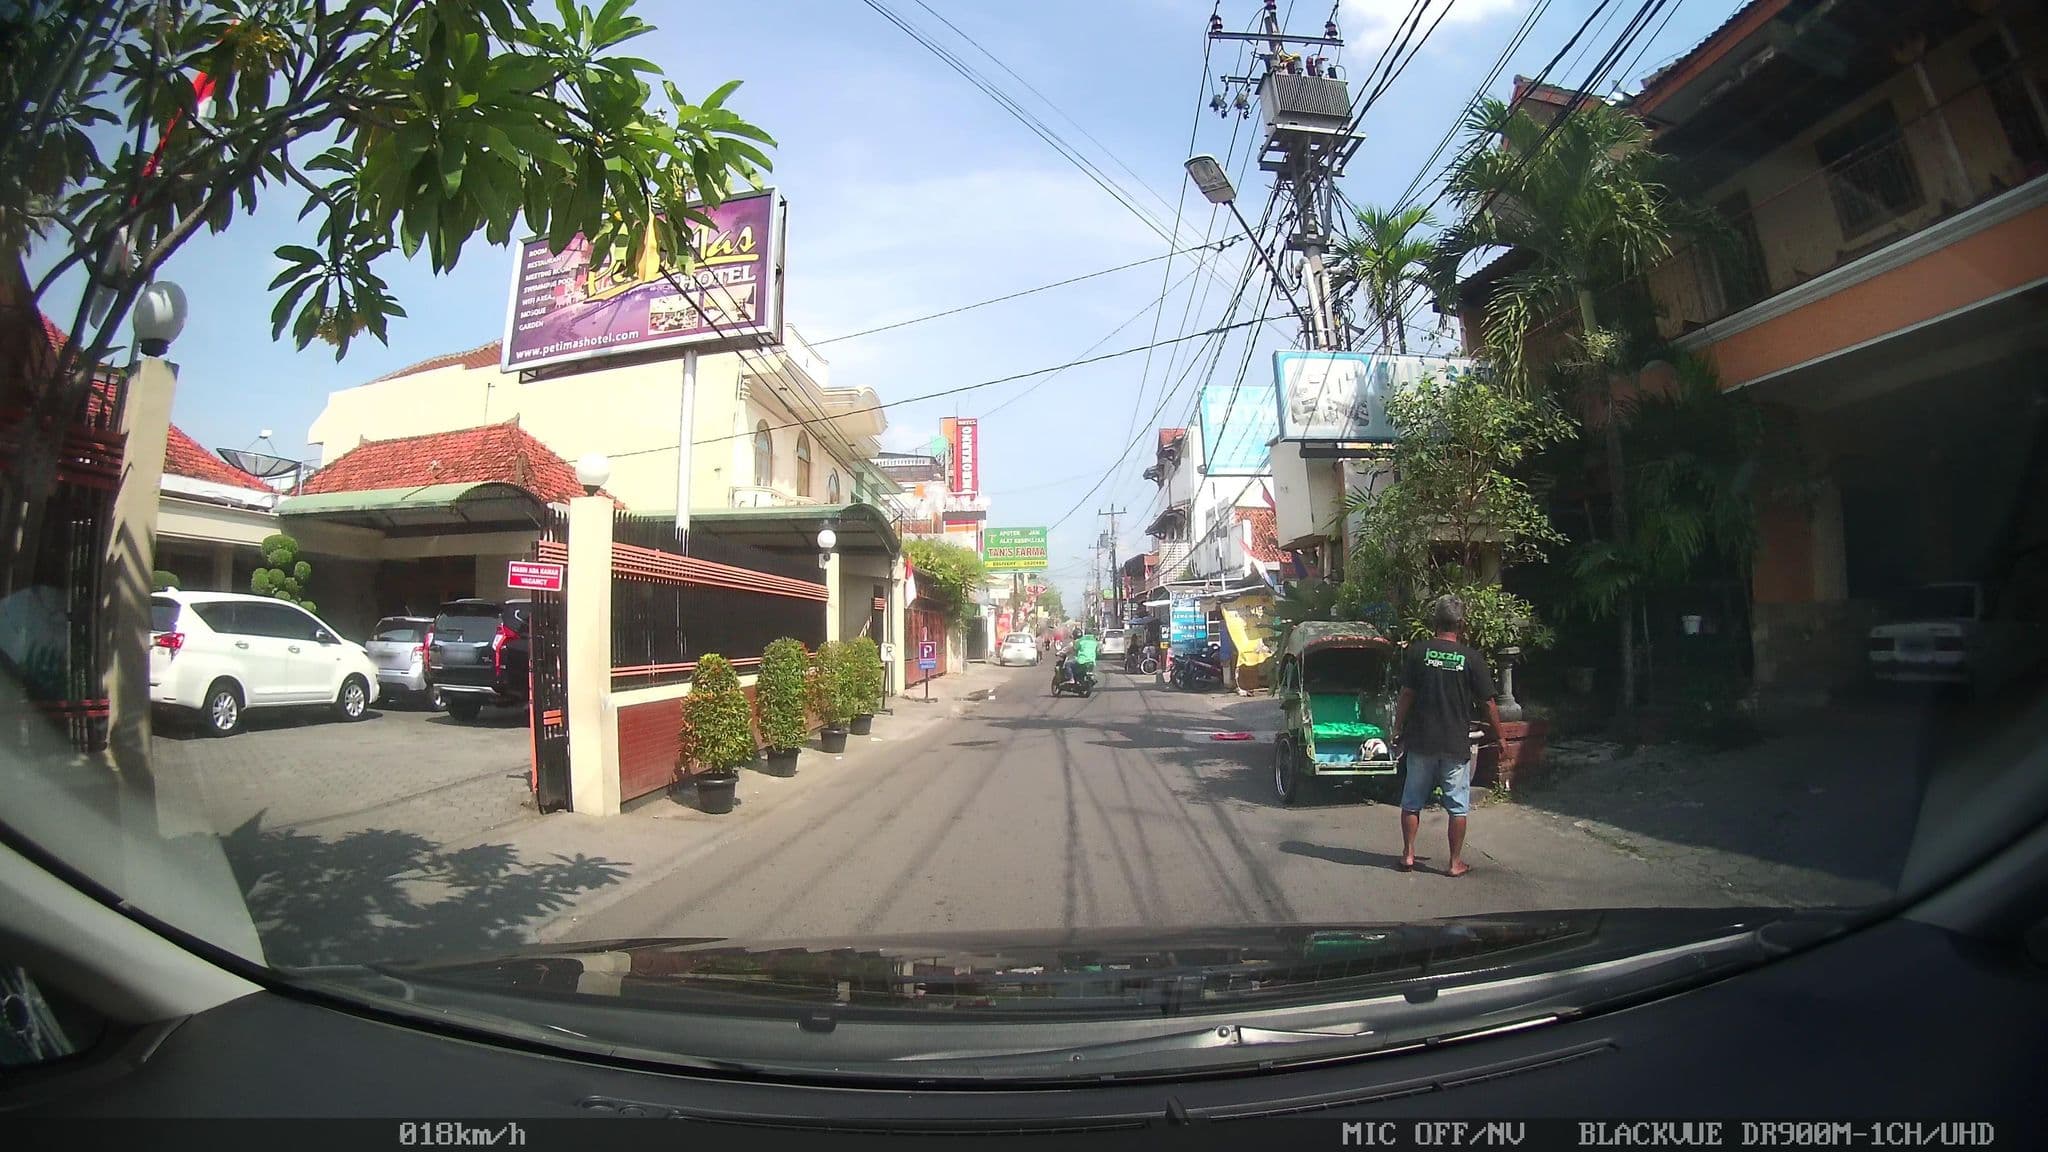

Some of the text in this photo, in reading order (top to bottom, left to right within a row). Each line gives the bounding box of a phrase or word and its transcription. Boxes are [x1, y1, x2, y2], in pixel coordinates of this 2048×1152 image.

[528, 247, 548, 258] ROOM
[526, 255, 565, 270] RESTAURANT
[525, 269, 552, 281] MEETING
[679, 264, 757, 291] HOTEL
[523, 280, 557, 294] SWIMMING
[520, 306, 547, 319] MOSQUE
[518, 320, 545, 331] GARDEN
[515, 330, 639, 359] www.petimashotel.com
[1015, 547, 1047, 557] FARMA
[520, 577, 548, 586] VACANCY
[1424, 648, 1465, 666] joxzin
